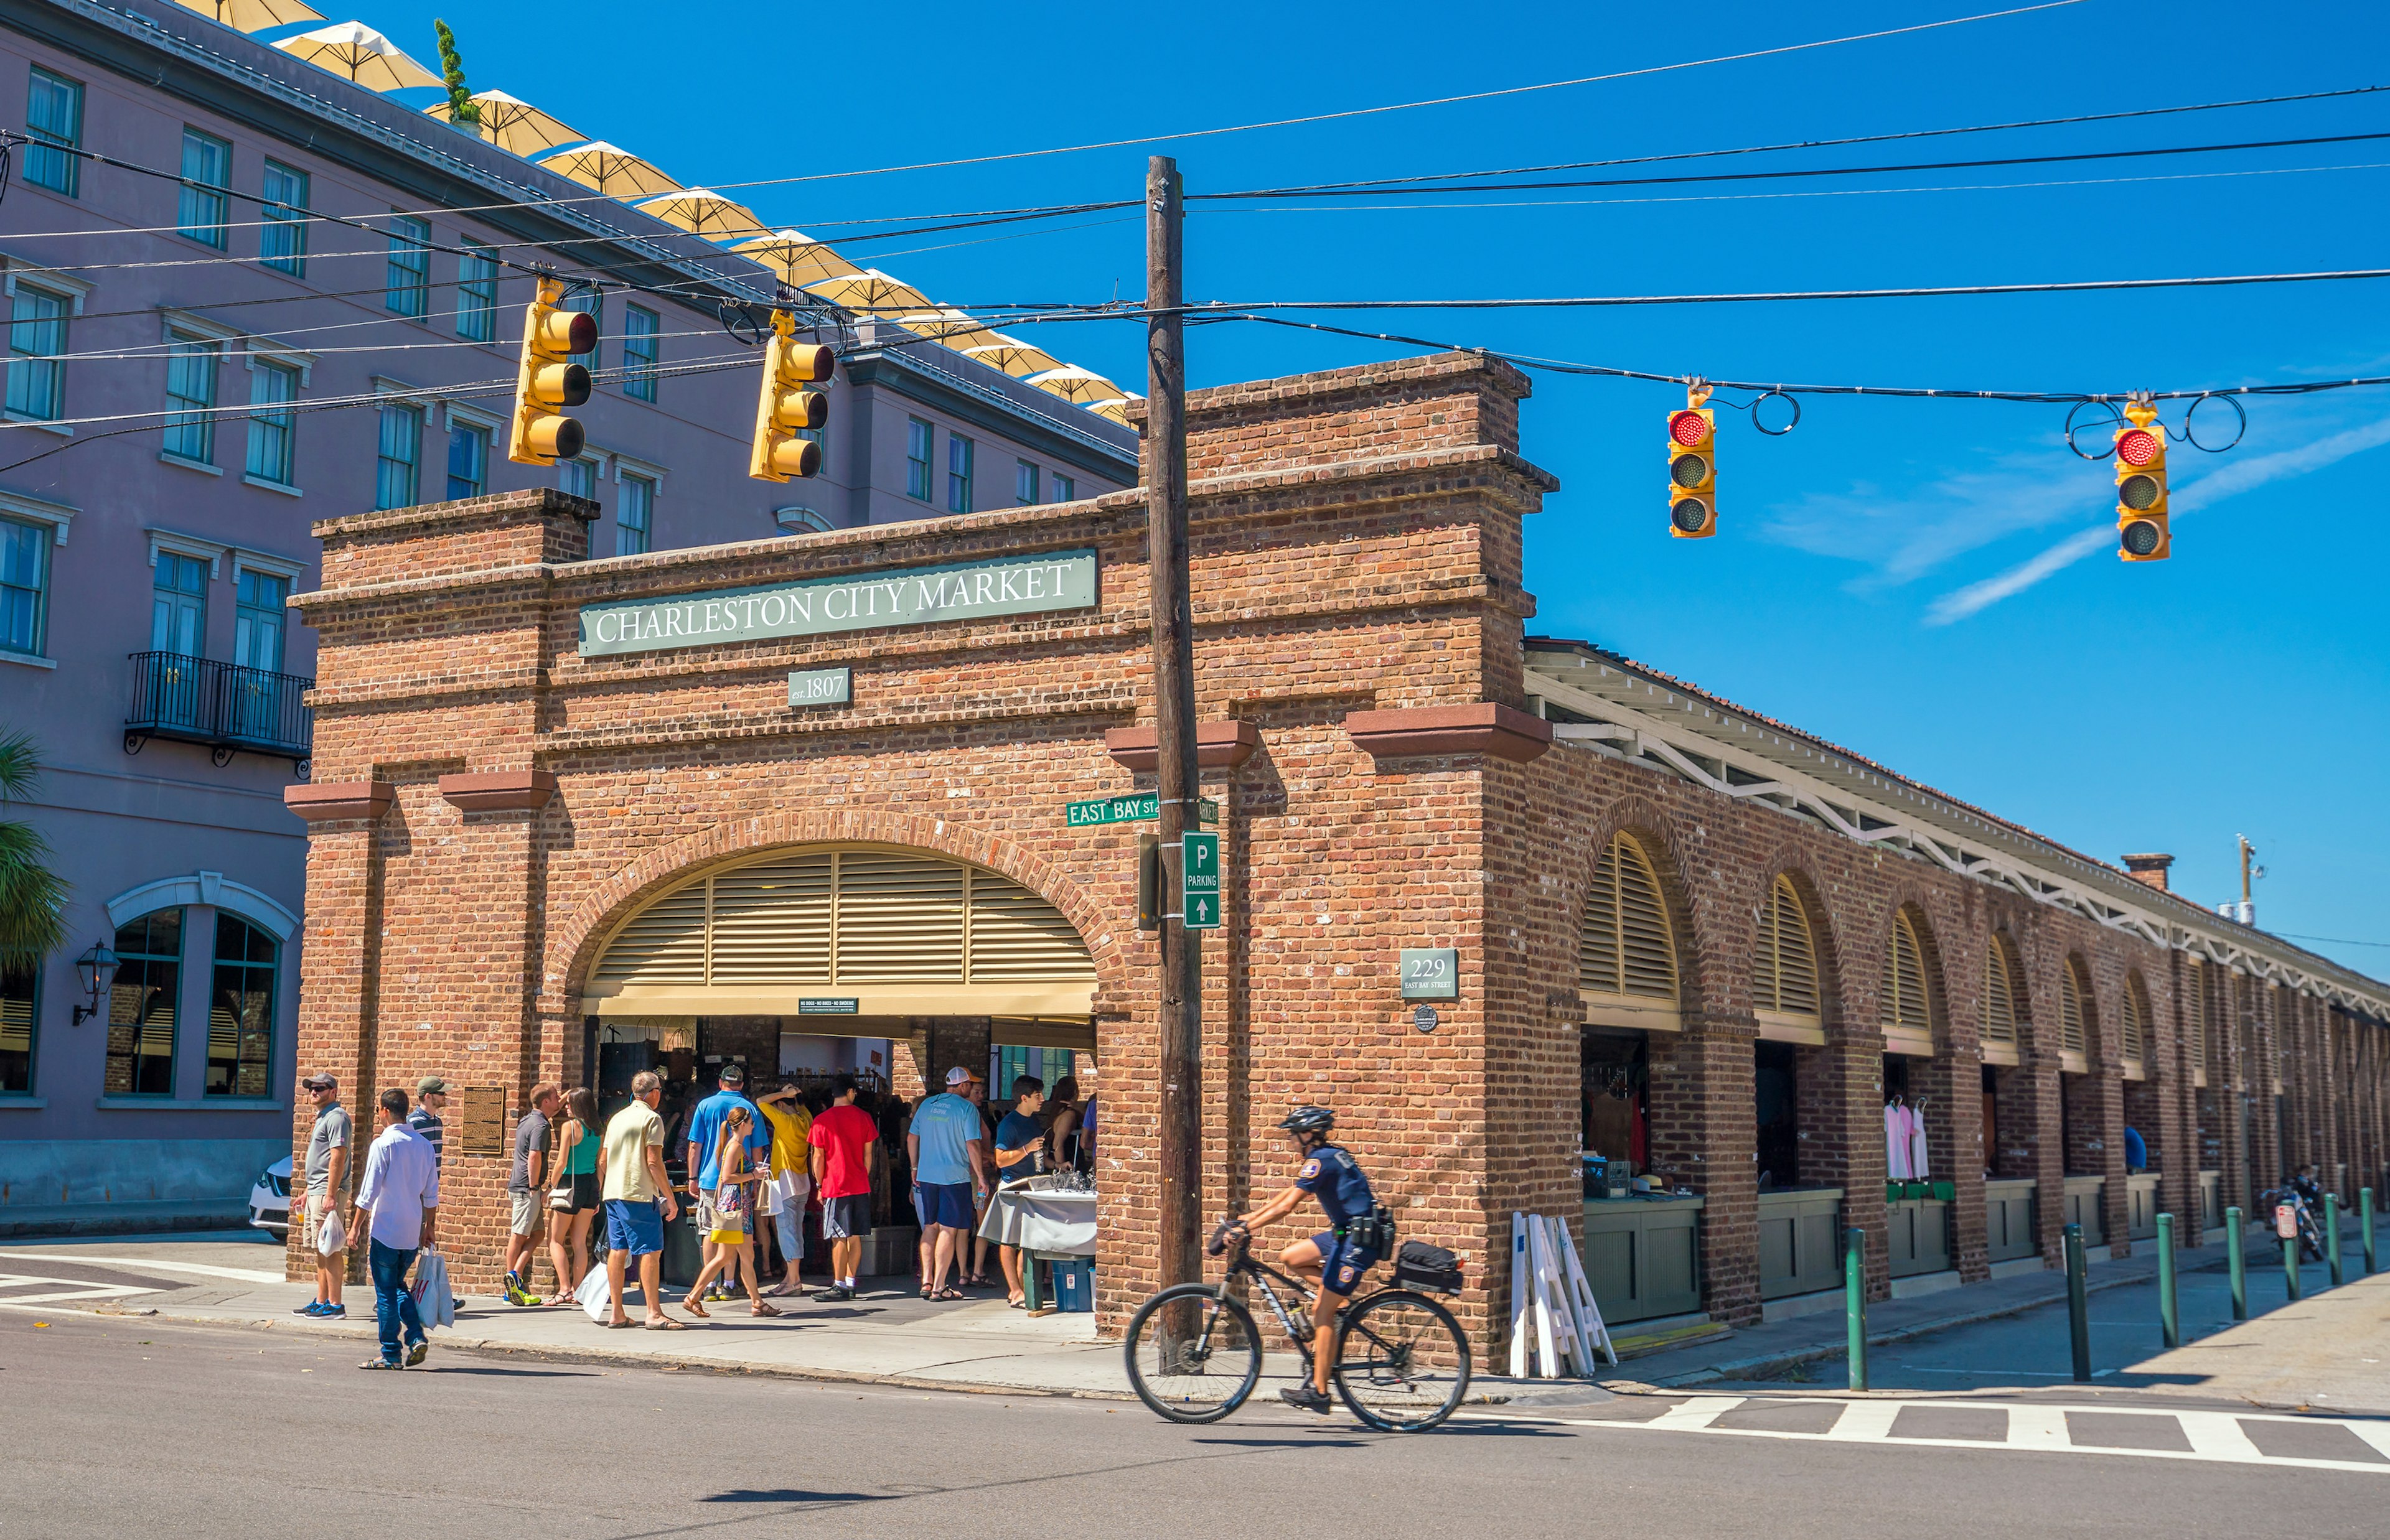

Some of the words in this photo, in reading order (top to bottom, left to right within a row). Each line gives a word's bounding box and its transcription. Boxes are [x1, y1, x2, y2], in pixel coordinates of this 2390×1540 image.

[596, 592, 812, 643] CHARLESTON
[824, 582, 906, 620] CITY
[916, 563, 1072, 611] MARKET
[792, 689, 805, 699] est.
[806, 675, 844, 698] 1807
[1069, 803, 1107, 824] EAST
[1113, 799, 1141, 819] BAY
[1143, 801, 1154, 813] ST
[1199, 802, 1214, 820] ARKET
[1197, 844, 1208, 869] P
[1188, 875, 1217, 887] PARKING
[1410, 959, 1445, 978] 229
